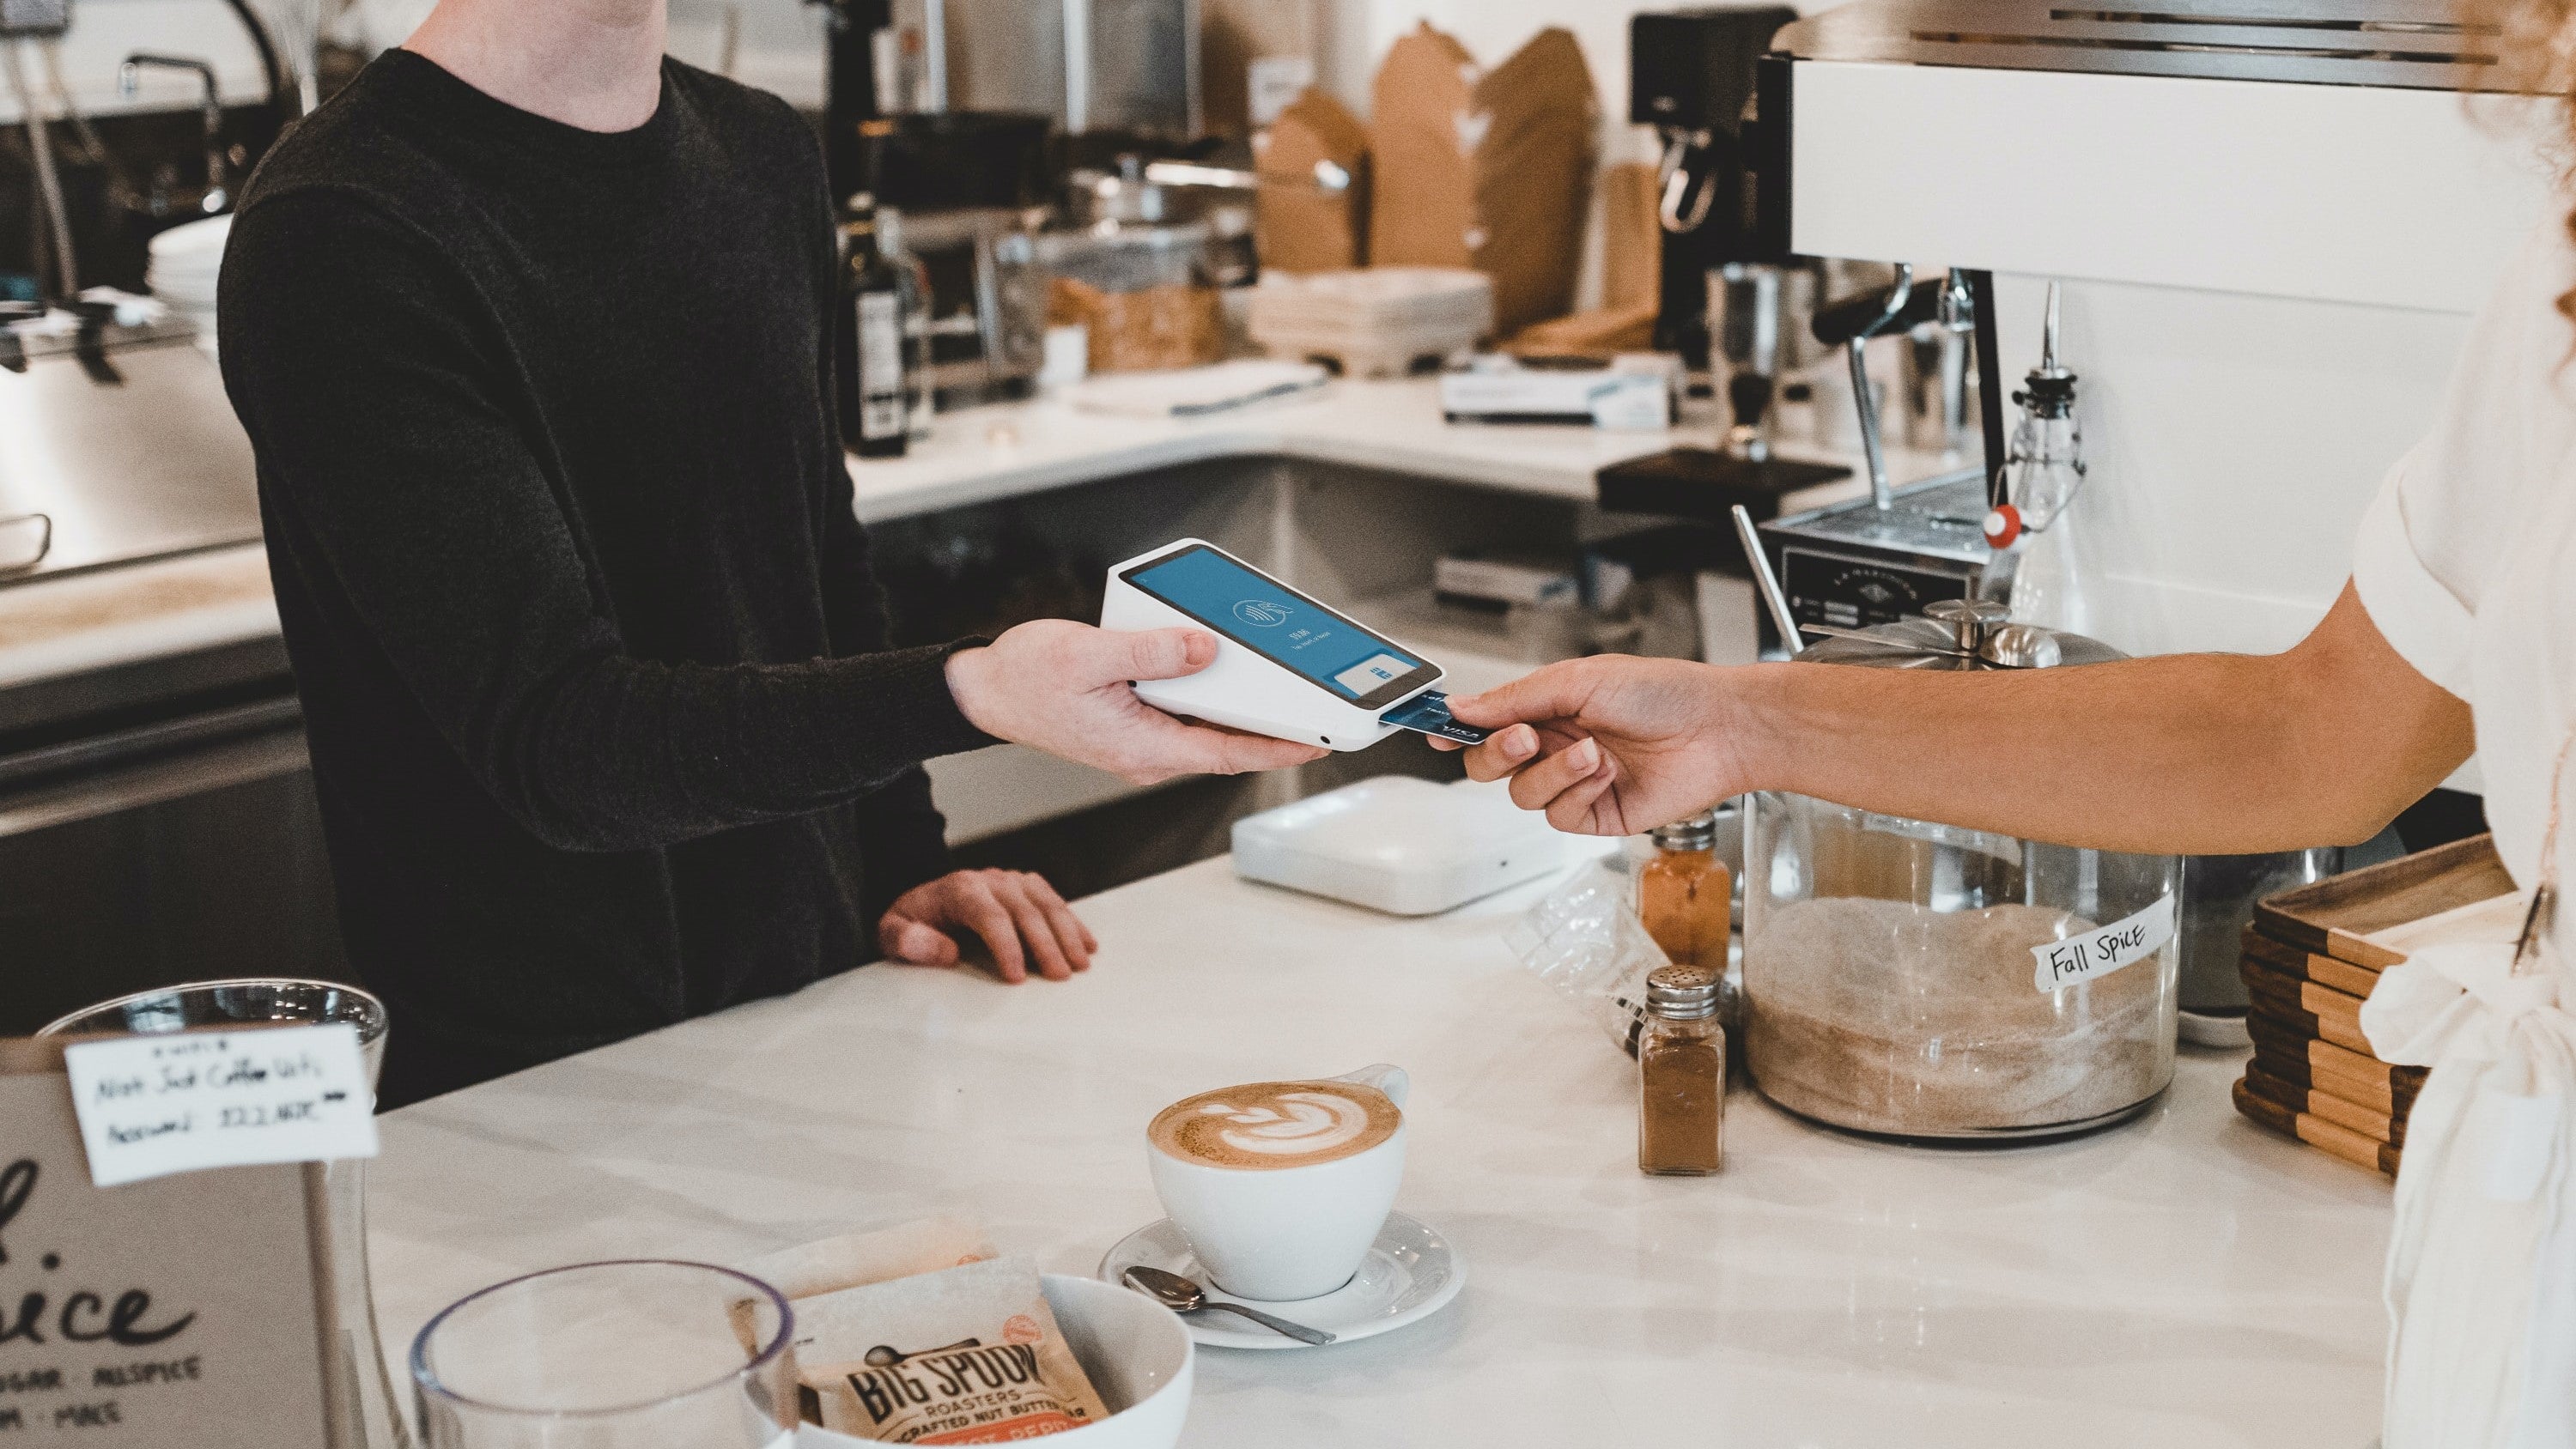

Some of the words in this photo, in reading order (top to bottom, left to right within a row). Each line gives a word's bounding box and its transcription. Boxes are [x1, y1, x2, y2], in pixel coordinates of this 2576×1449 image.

[1443, 724, 1479, 738] VISA
[2050, 945, 2089, 981] Fall
[0, 1288, 197, 1347] ice
[847, 1365, 931, 1426] BIG
[919, 1343, 1046, 1397] SPOON
[924, 1390, 1021, 1418] ROASTERS
[973, 1408, 1004, 1422] NUT
